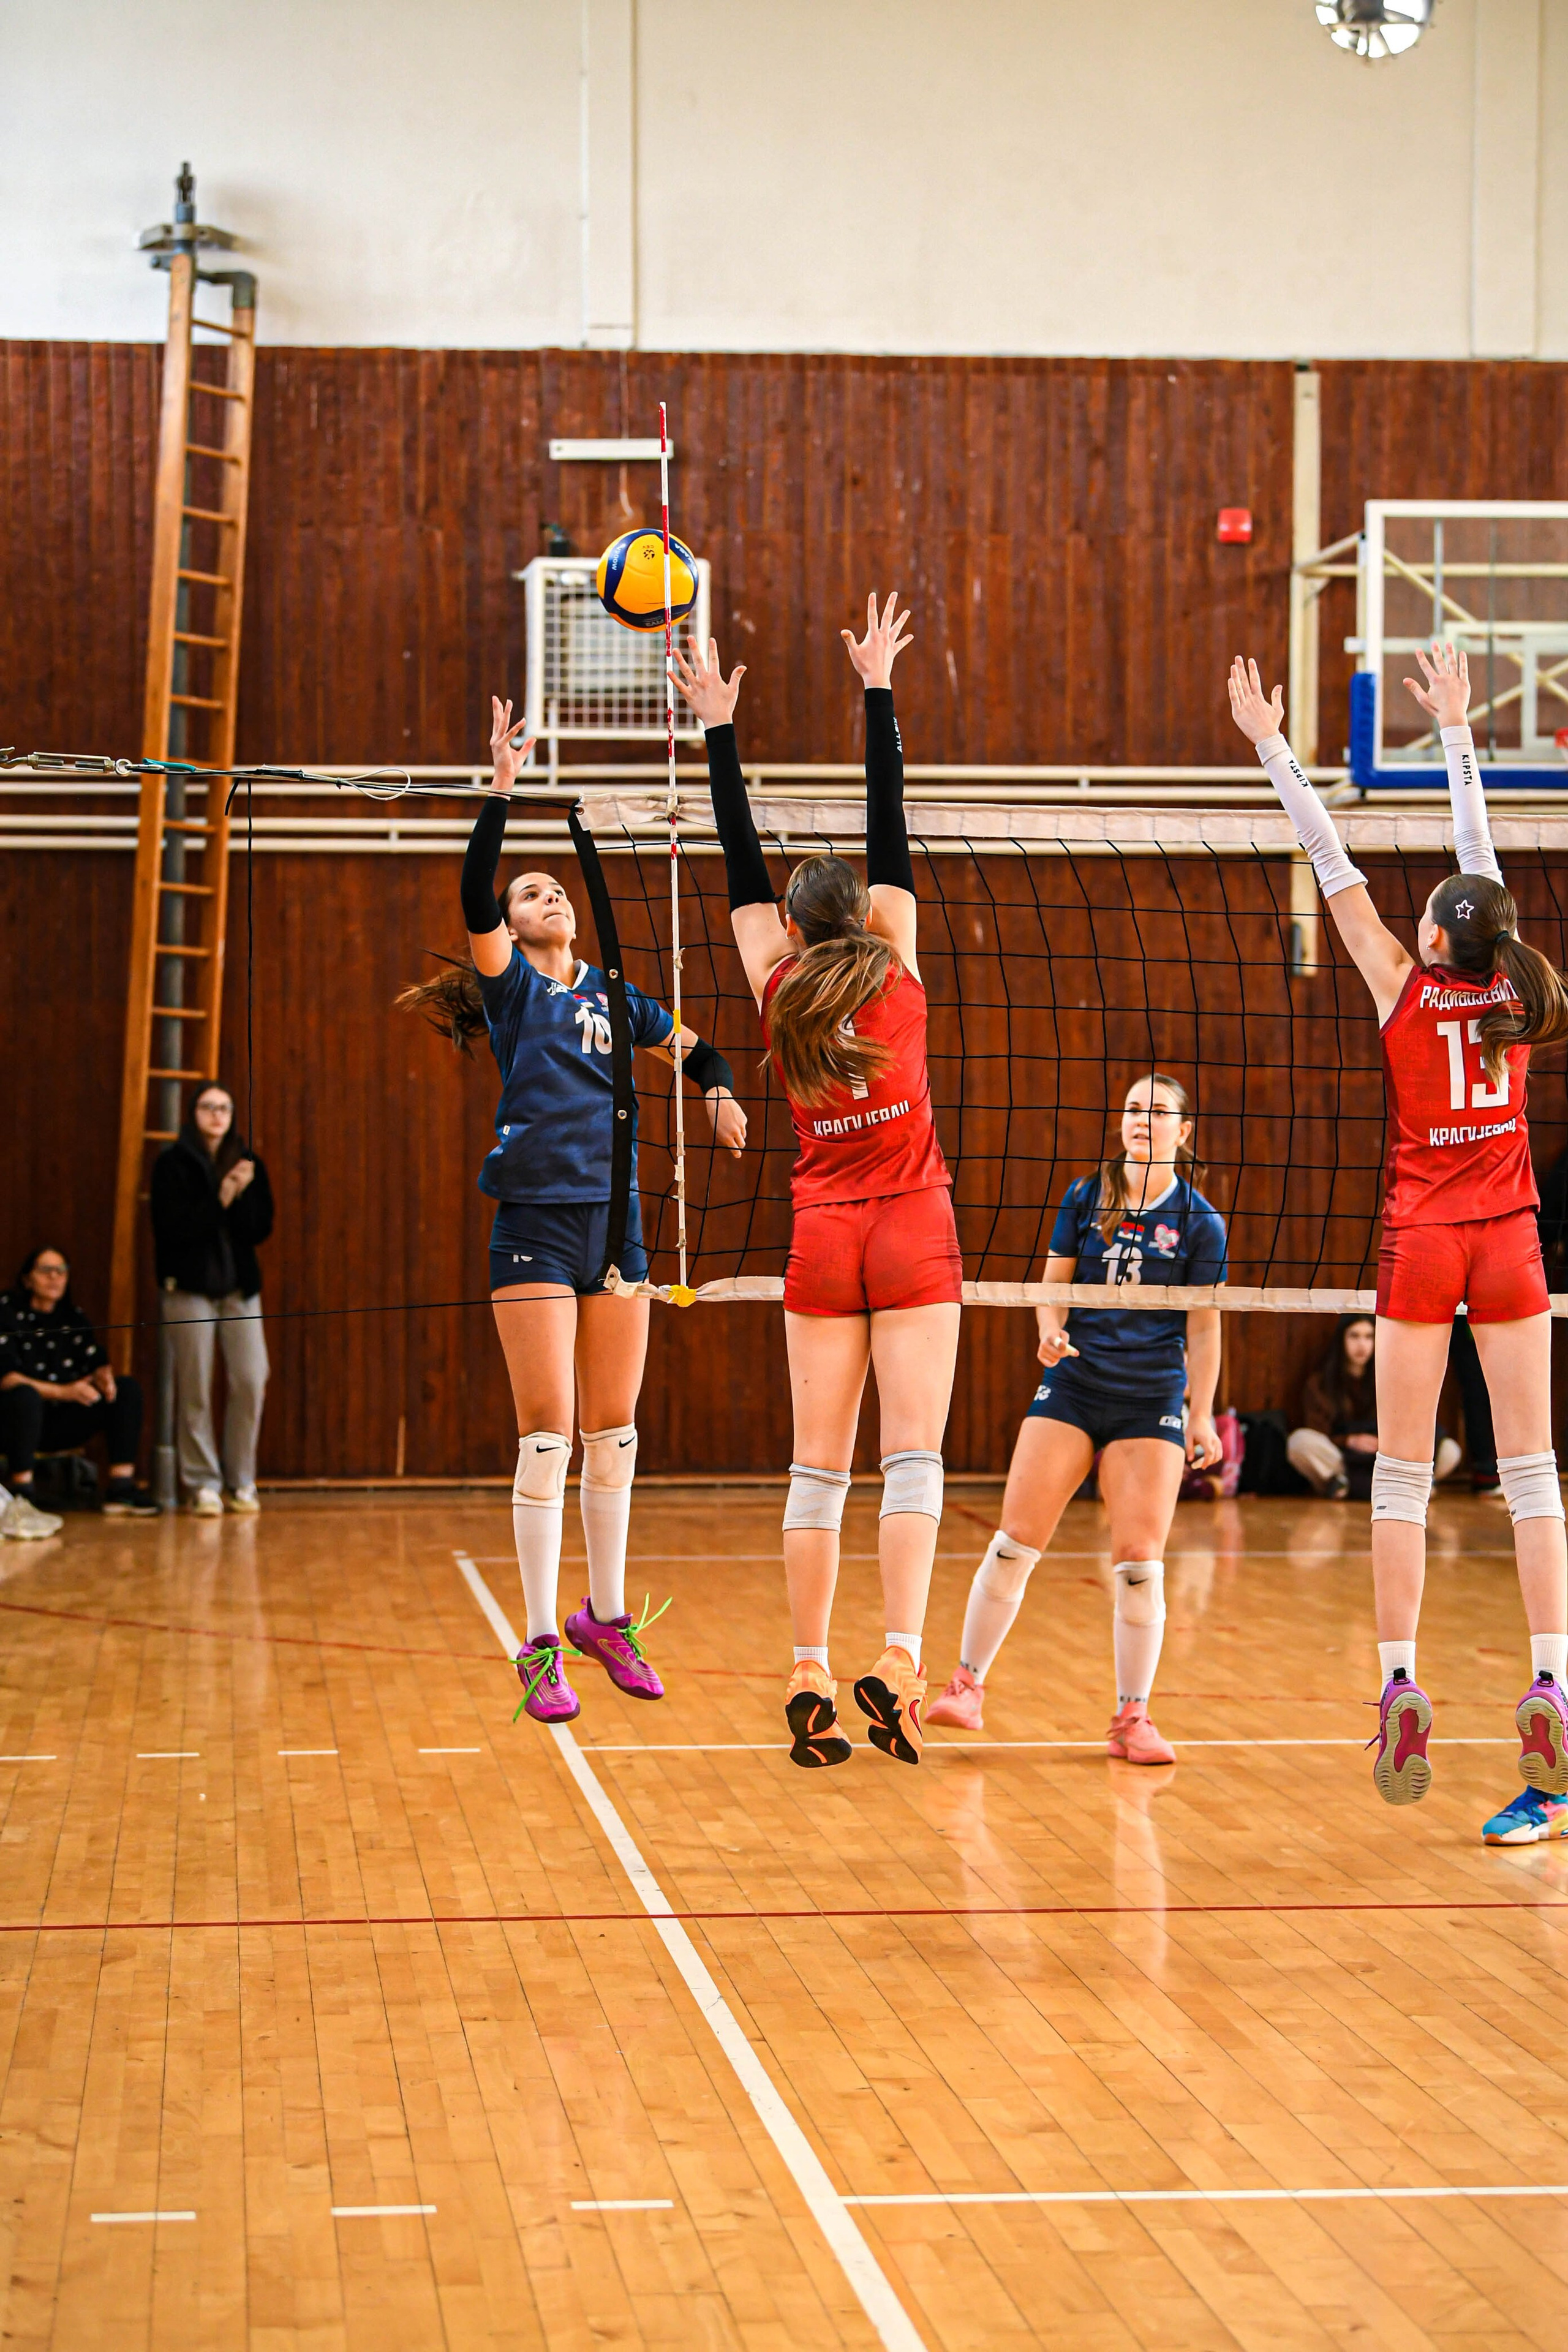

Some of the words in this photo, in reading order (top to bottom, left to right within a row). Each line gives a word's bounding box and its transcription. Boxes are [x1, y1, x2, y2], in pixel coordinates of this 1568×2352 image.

[1288, 760, 1309, 788] KIPSTA
[1462, 754, 1472, 786] KIPSTA
[575, 1006, 612, 1055] 10
[1101, 1242, 1144, 1286] 13
